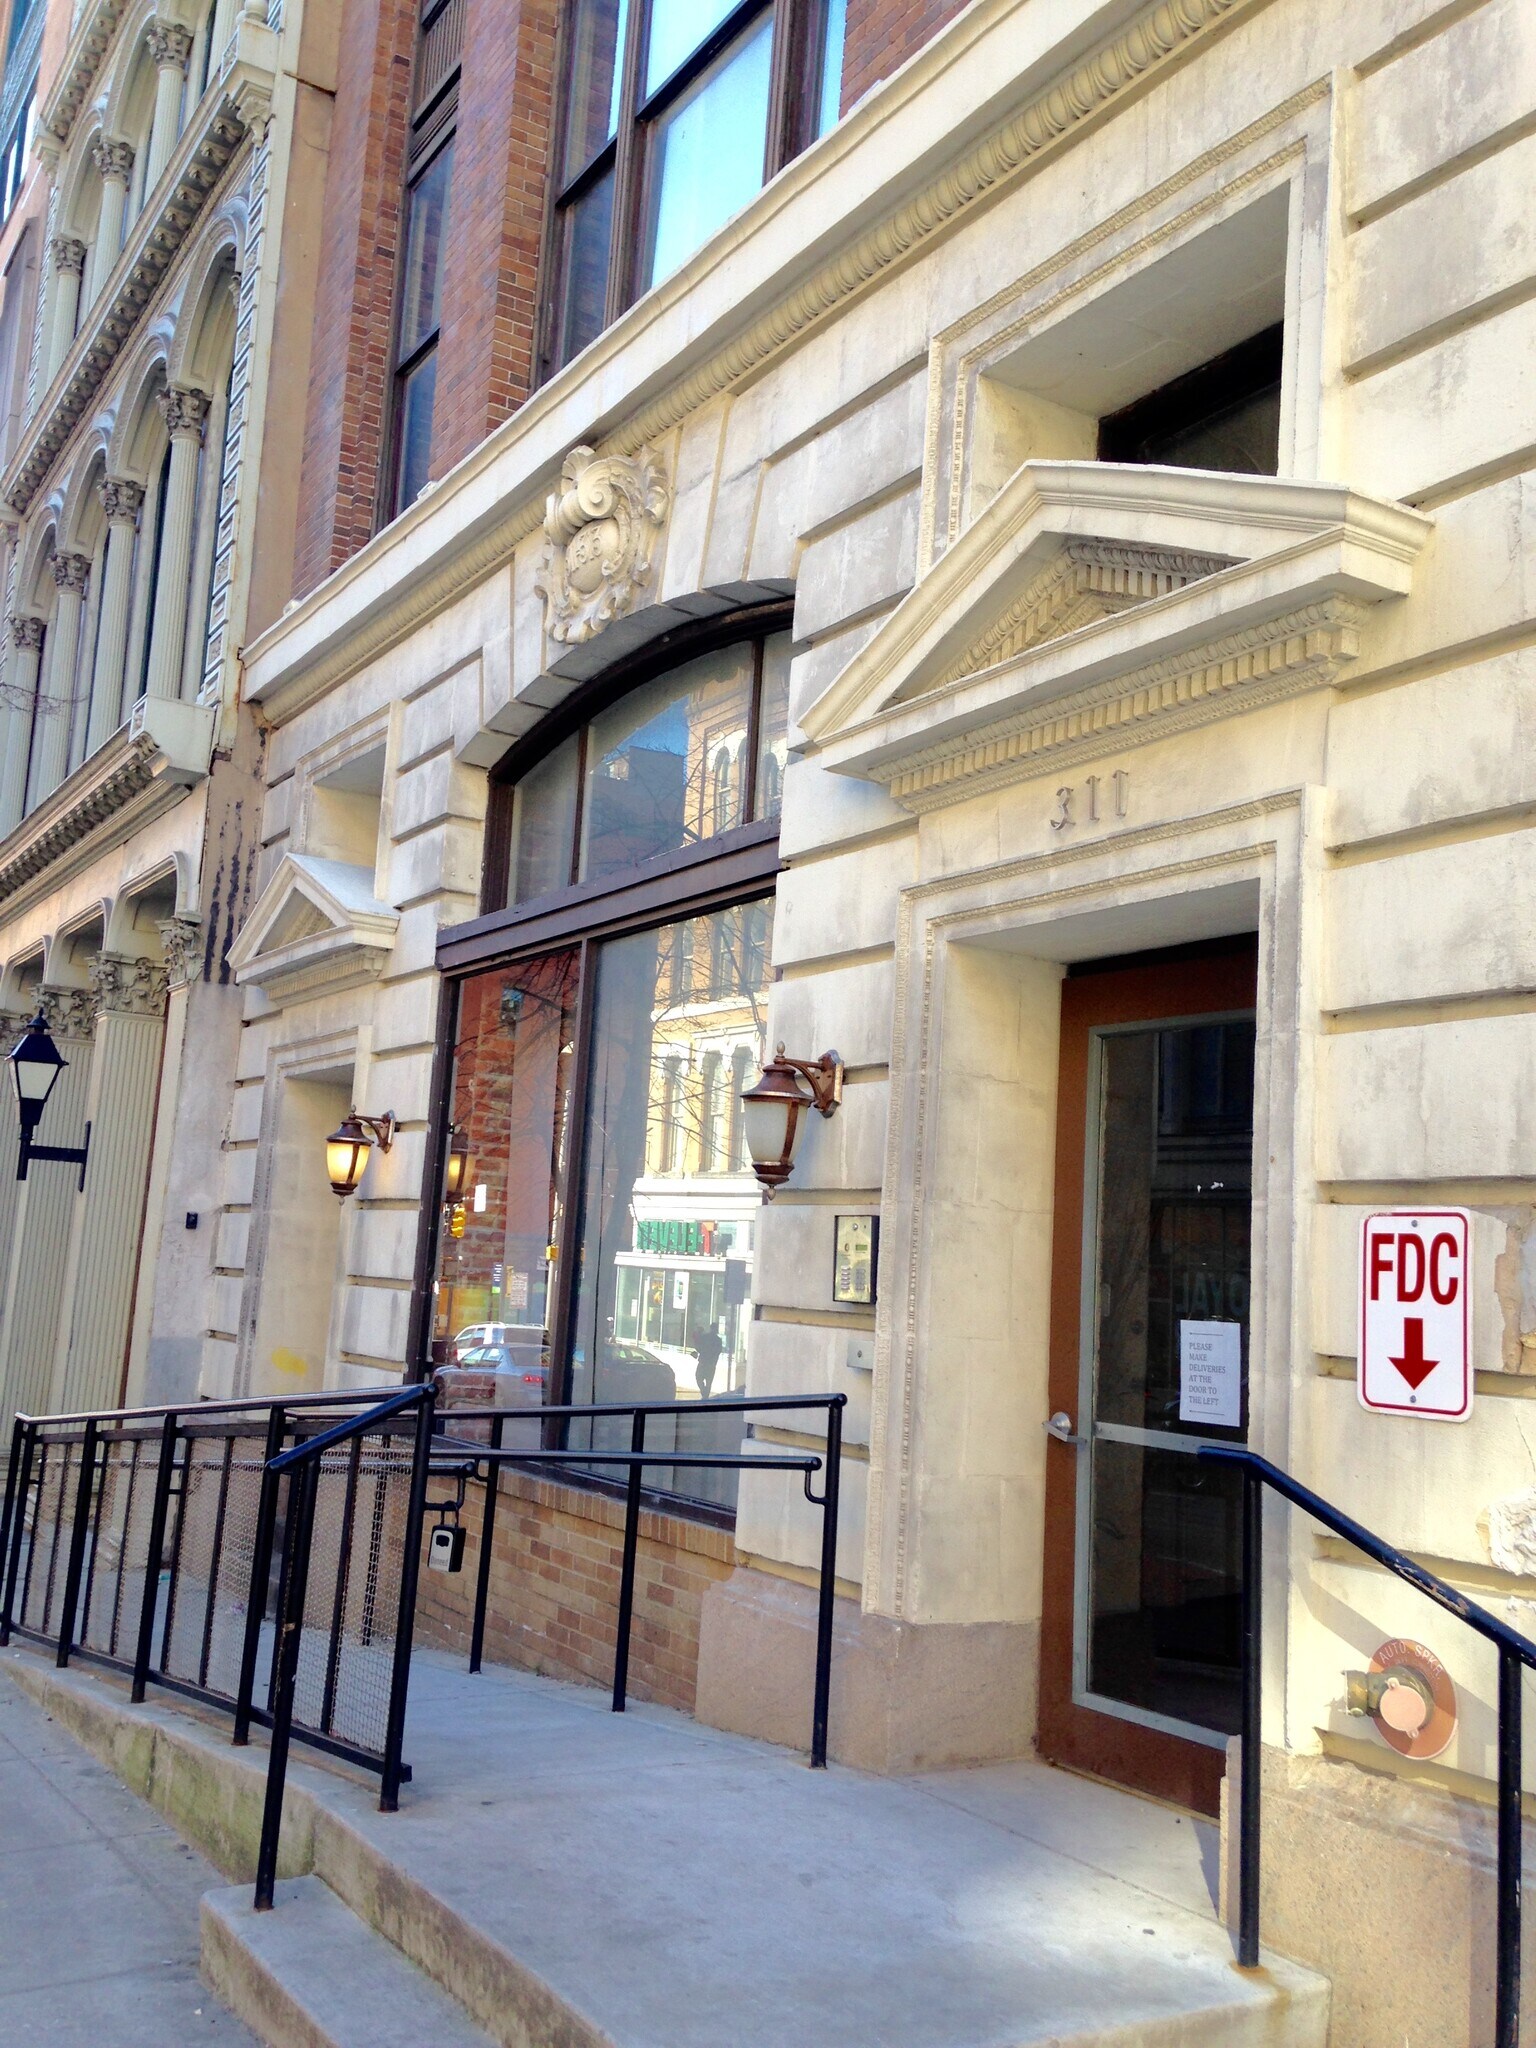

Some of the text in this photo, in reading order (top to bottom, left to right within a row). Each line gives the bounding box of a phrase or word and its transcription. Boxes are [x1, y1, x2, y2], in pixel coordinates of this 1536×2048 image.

[1050, 769, 1129, 830] 311
[1370, 1232, 1459, 1305] FDC
[1189, 1342, 1213, 1351] PLEASE
[1189, 1353, 1208, 1361] MAKE
[1189, 1364, 1226, 1374] DELIVERIES
[1189, 1375, 1212, 1384] AT THE
[1189, 1385, 1217, 1395] DOOR TO
[1189, 1395, 1219, 1406] THE LEFT
[1379, 1640, 1410, 1664] AUTO.
